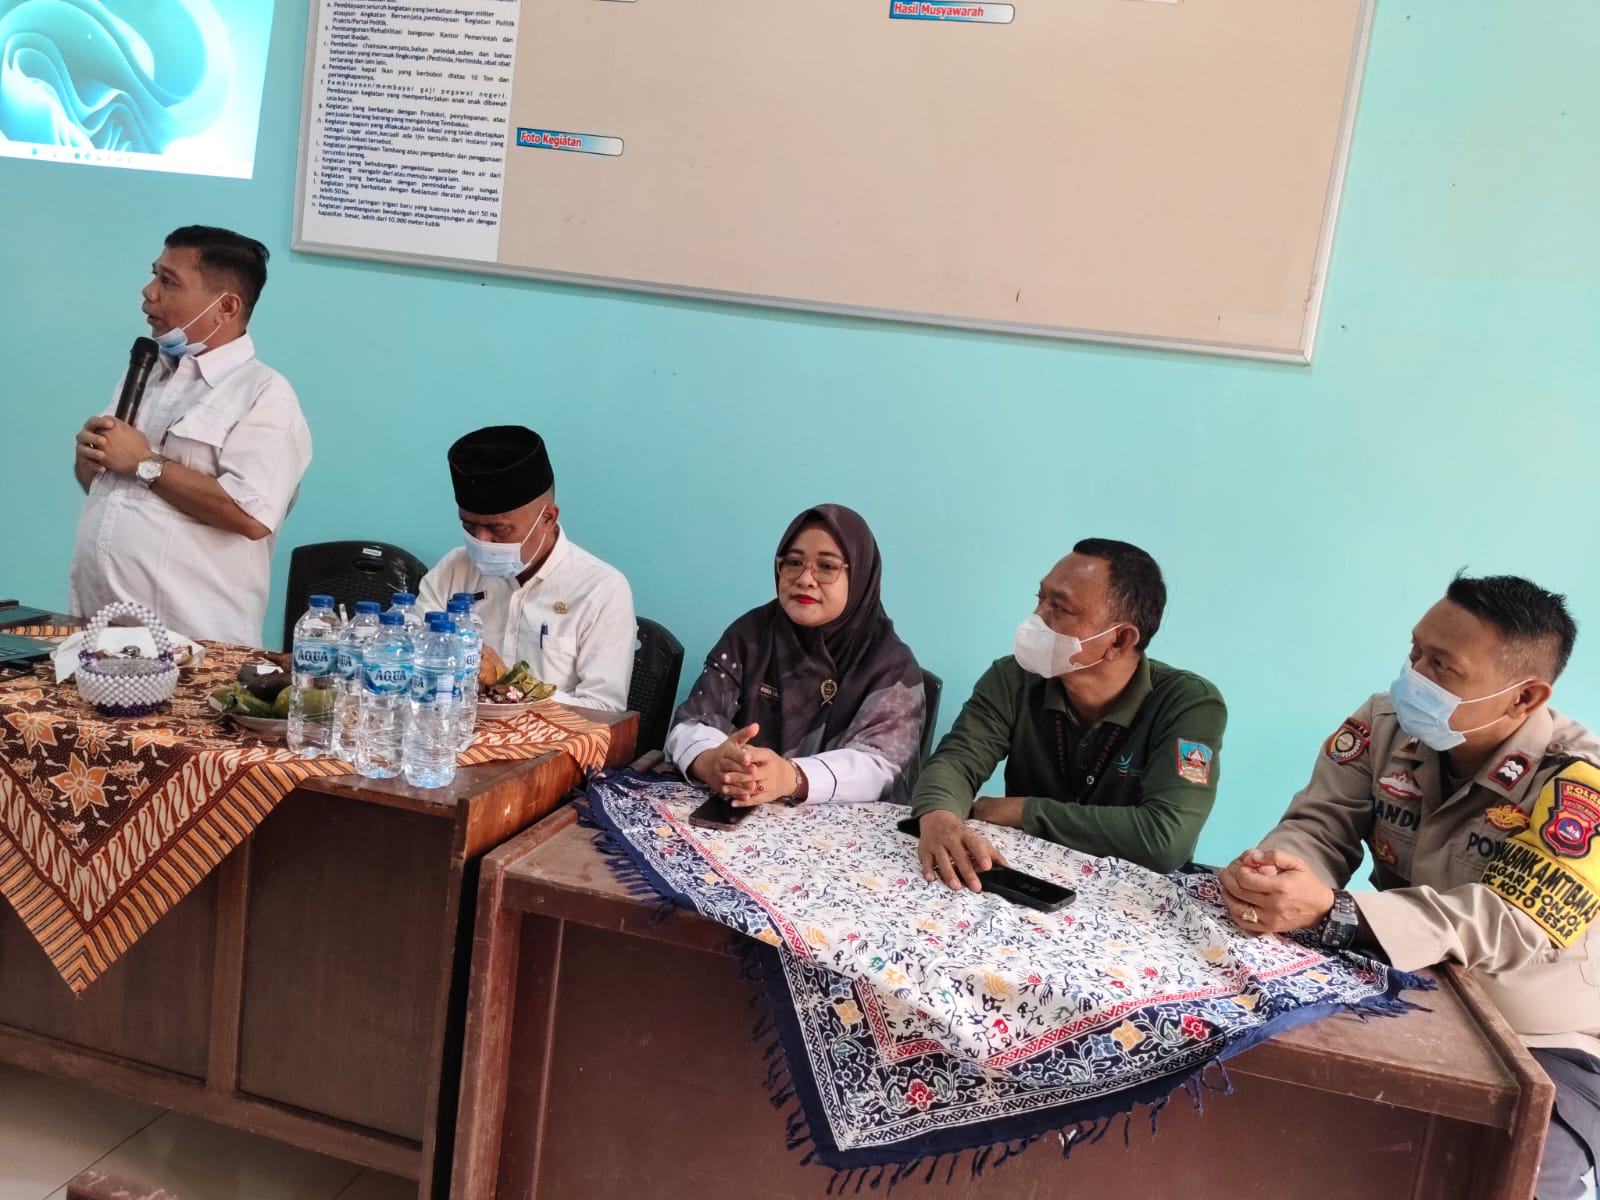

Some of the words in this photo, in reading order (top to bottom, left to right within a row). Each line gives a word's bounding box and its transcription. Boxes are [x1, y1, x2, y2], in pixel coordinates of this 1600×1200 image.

[893, 3, 918, 14] Hasil
[920, 4, 984, 18] Musyawarah
[520, 131, 541, 143] Foto
[542, 134, 582, 147] Kegiatan
[297, 650, 328, 663] AQUA
[337, 655, 352, 667] UA
[375, 669, 406, 682] AQUA
[1497, 881, 1536, 909] KOTO
[1536, 907, 1574, 940] BESAR
[1531, 886, 1581, 931] BONJOL
